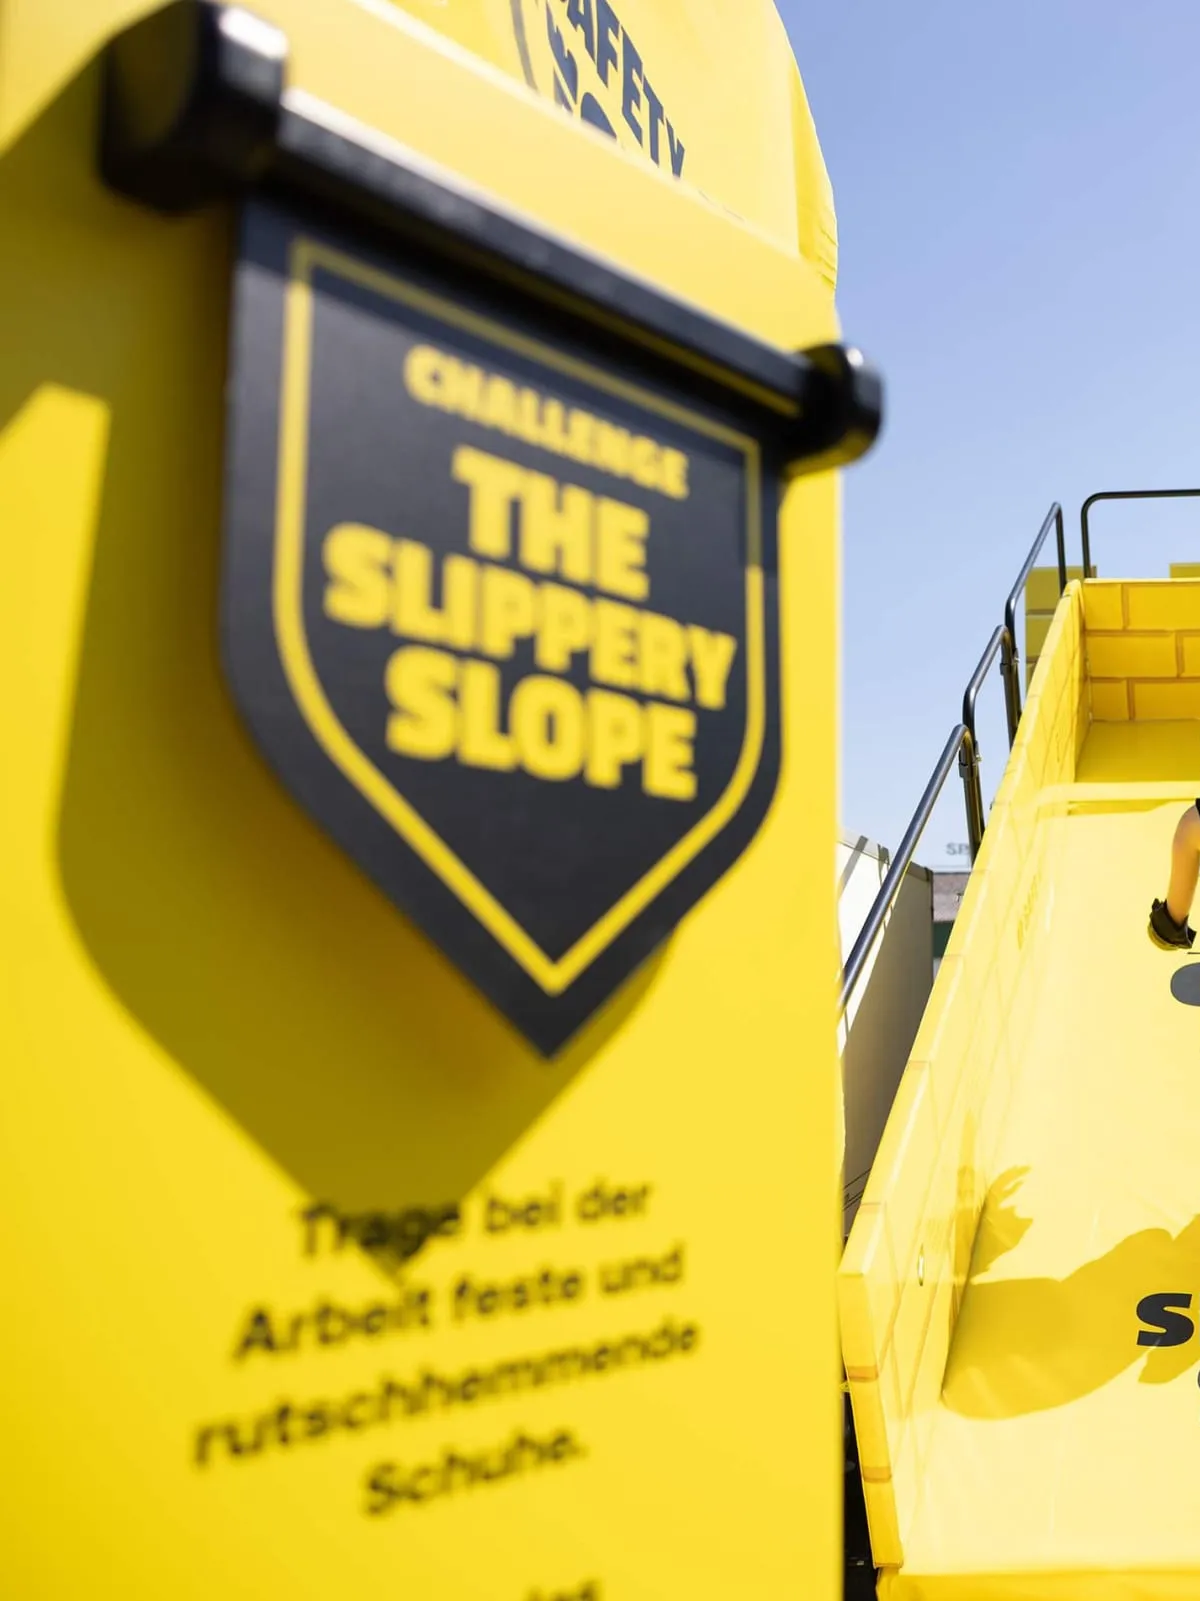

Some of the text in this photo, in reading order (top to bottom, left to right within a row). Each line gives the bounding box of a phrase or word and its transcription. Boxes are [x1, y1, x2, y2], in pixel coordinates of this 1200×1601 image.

[405, 344, 690, 500] CHALLENGE
[451, 443, 650, 601] THE
[322, 521, 738, 711] SLIPPERY
[384, 644, 698, 801] SLOPE
[299, 1180, 652, 1257] Trage bei der
[232, 1244, 687, 1370] Arbeit feste und
[192, 1316, 700, 1473] rutschhemmende
[362, 1427, 588, 1518] Schuhe.
